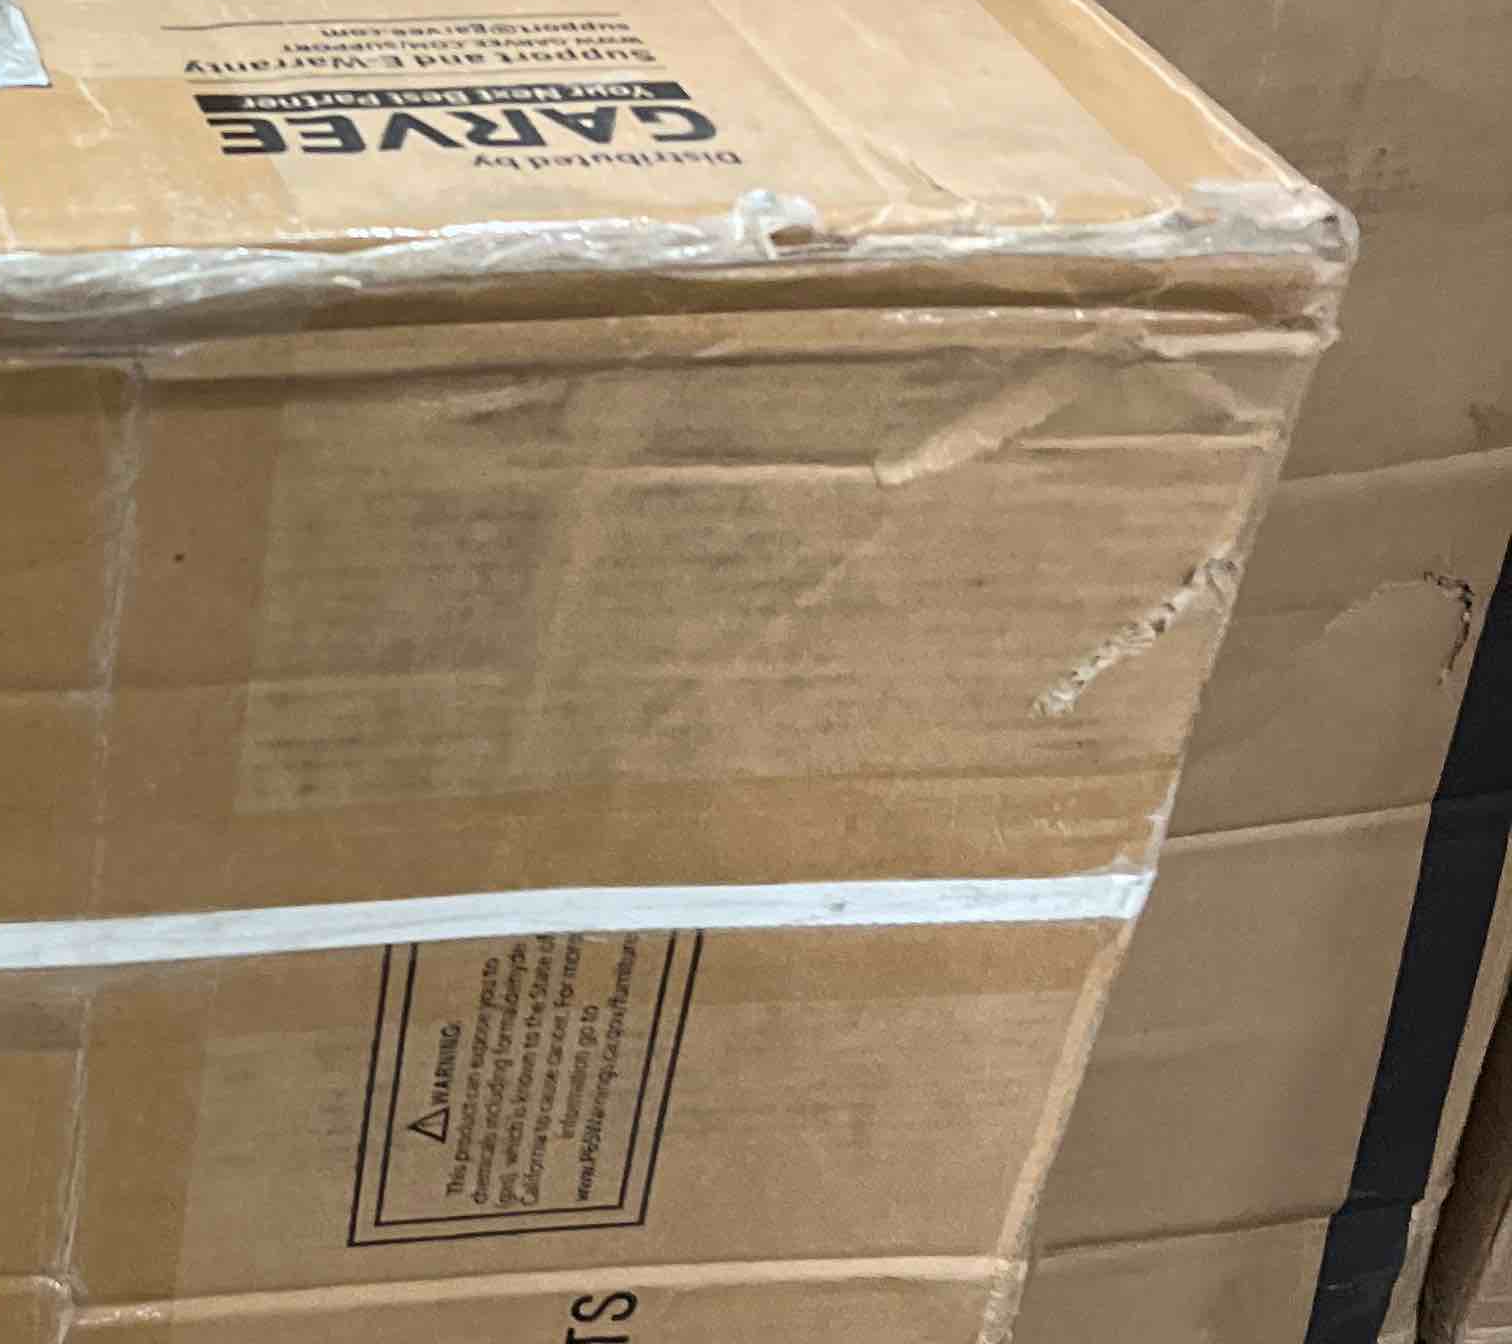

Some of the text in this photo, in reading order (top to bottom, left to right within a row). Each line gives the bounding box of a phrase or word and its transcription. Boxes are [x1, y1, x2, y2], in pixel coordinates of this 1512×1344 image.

[184, 54, 405, 74] E-Warranty
[496, 47, 656, 64] Support
[243, 82, 655, 109] Your Next Best Partner
[206, 105, 717, 154] GARVEE
[473, 150, 742, 170] Distributed by
